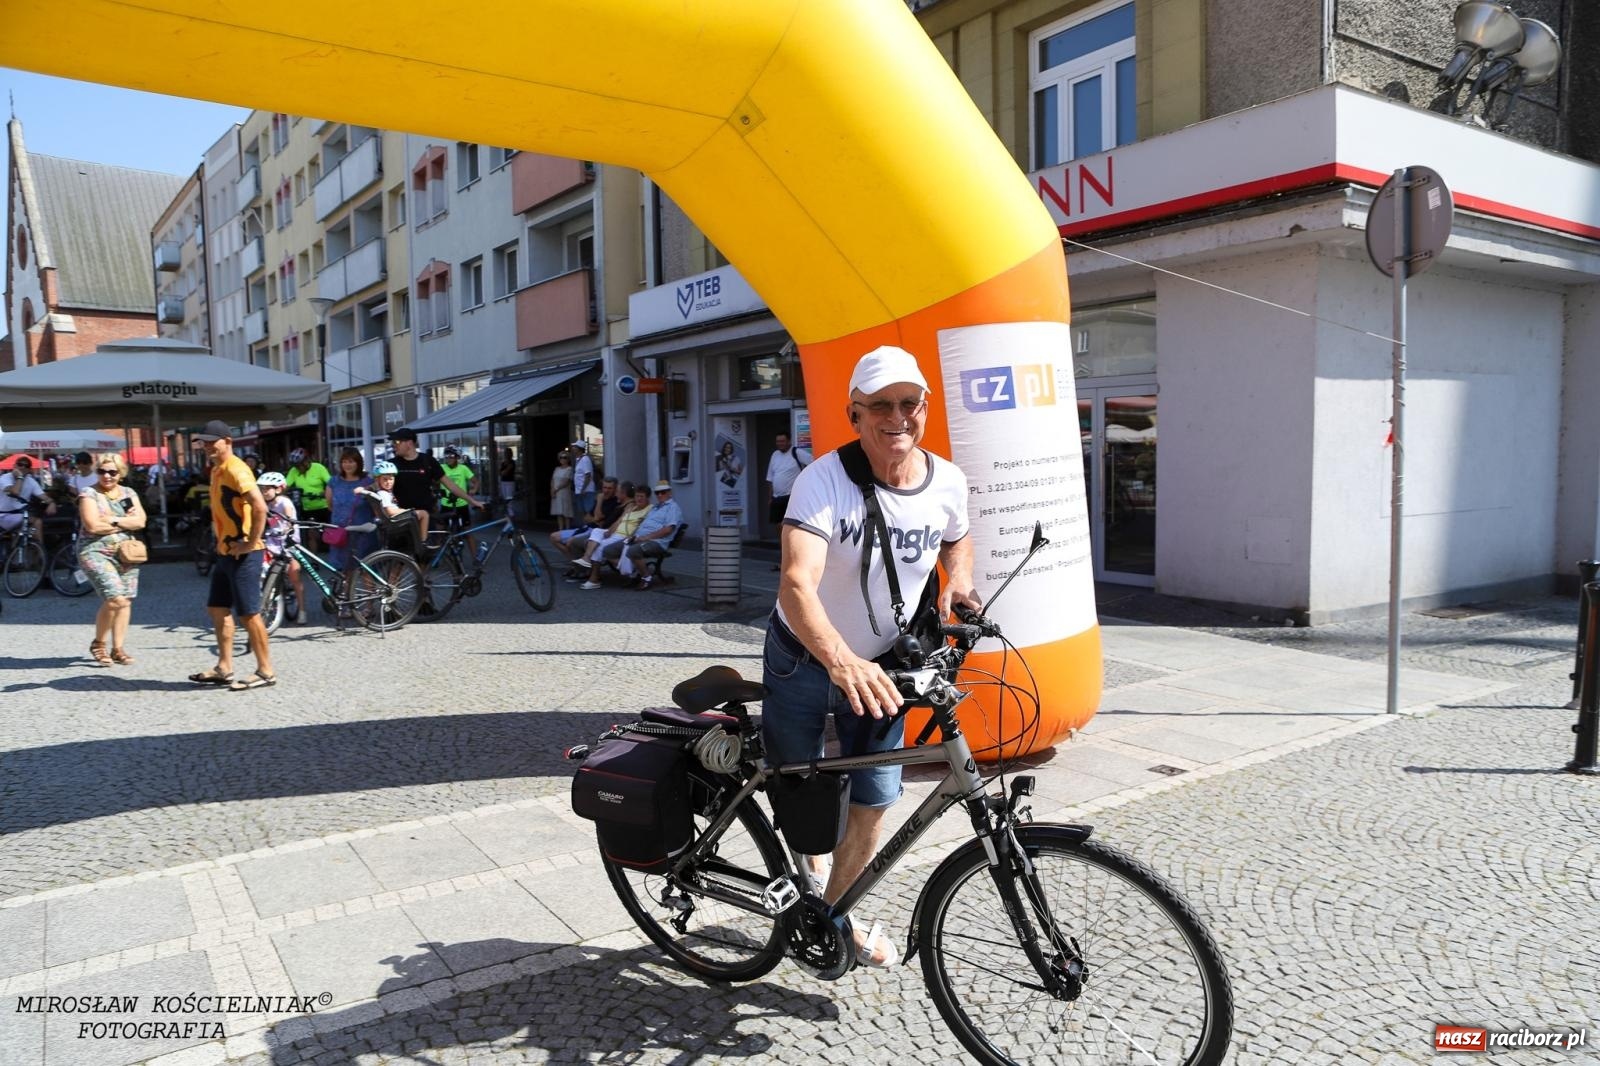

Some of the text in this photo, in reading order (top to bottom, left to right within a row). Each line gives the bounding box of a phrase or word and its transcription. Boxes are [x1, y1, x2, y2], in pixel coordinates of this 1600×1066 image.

[695, 275, 720, 299] TEB
[122, 382, 198, 398] gelatopiu
[993, 460, 1023, 471] Projekt
[979, 507, 997, 518] jest
[597, 790, 625, 800] CAMARO
[871, 811, 923, 874] UNIBIKE
